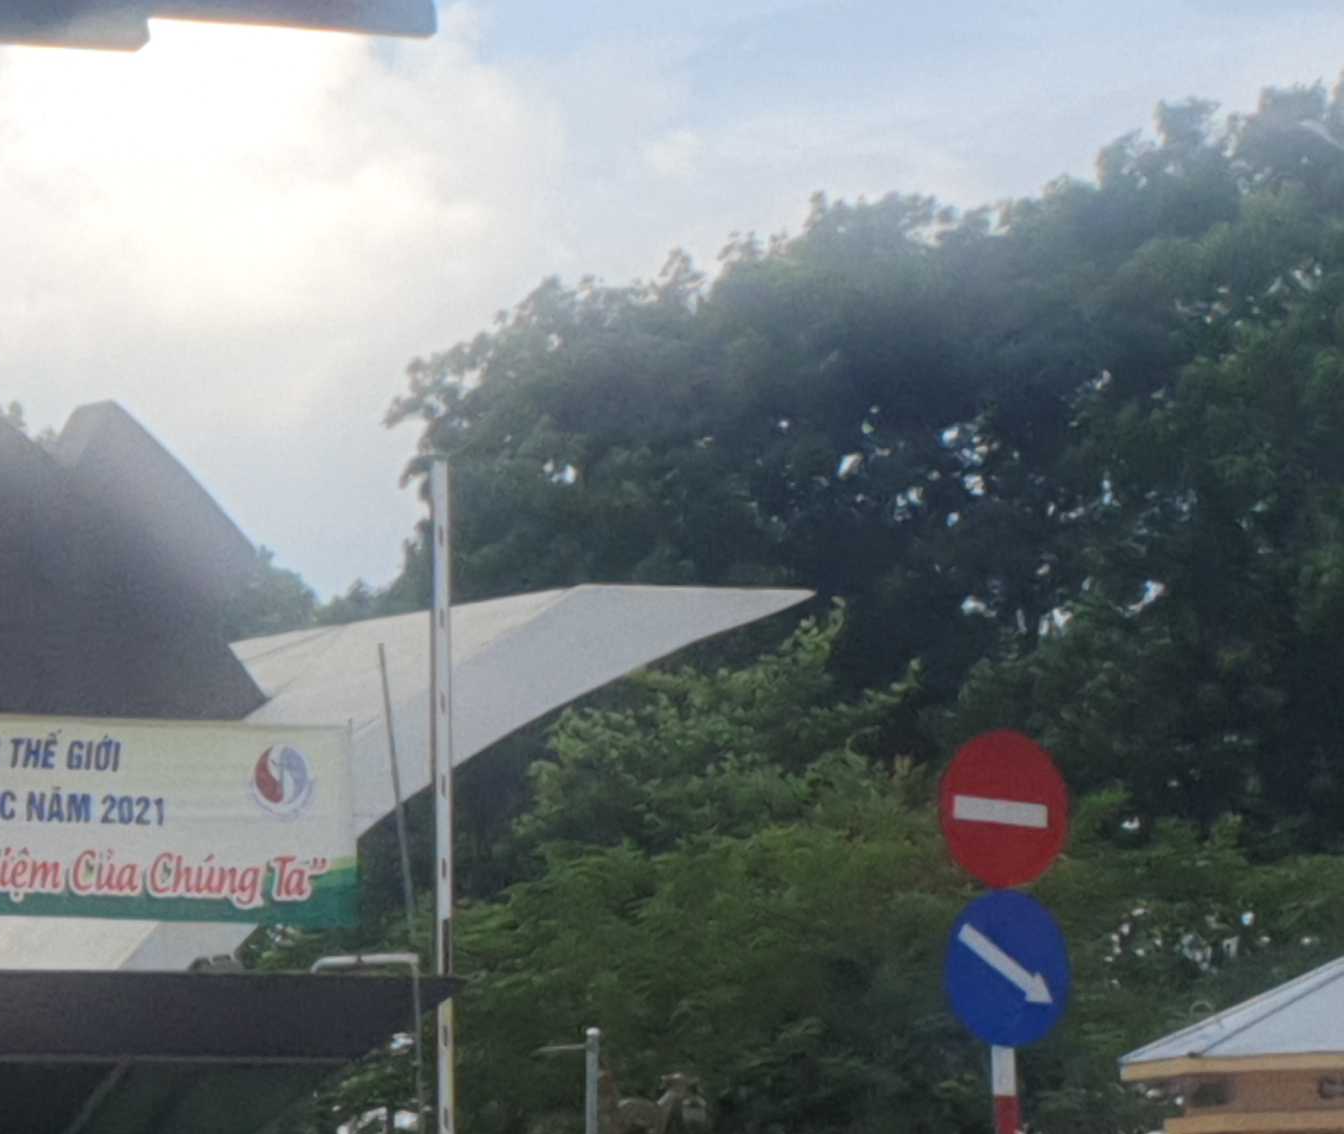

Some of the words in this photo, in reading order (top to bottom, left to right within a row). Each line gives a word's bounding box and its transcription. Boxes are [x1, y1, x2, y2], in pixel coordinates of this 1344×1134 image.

[10, 729, 63, 769] THẾ
[66, 734, 122, 772] GIỚI
[25, 786, 92, 822] NĂM
[100, 793, 165, 826] 2021
[70, 848, 141, 896] Của
[148, 851, 265, 908] Chúng
